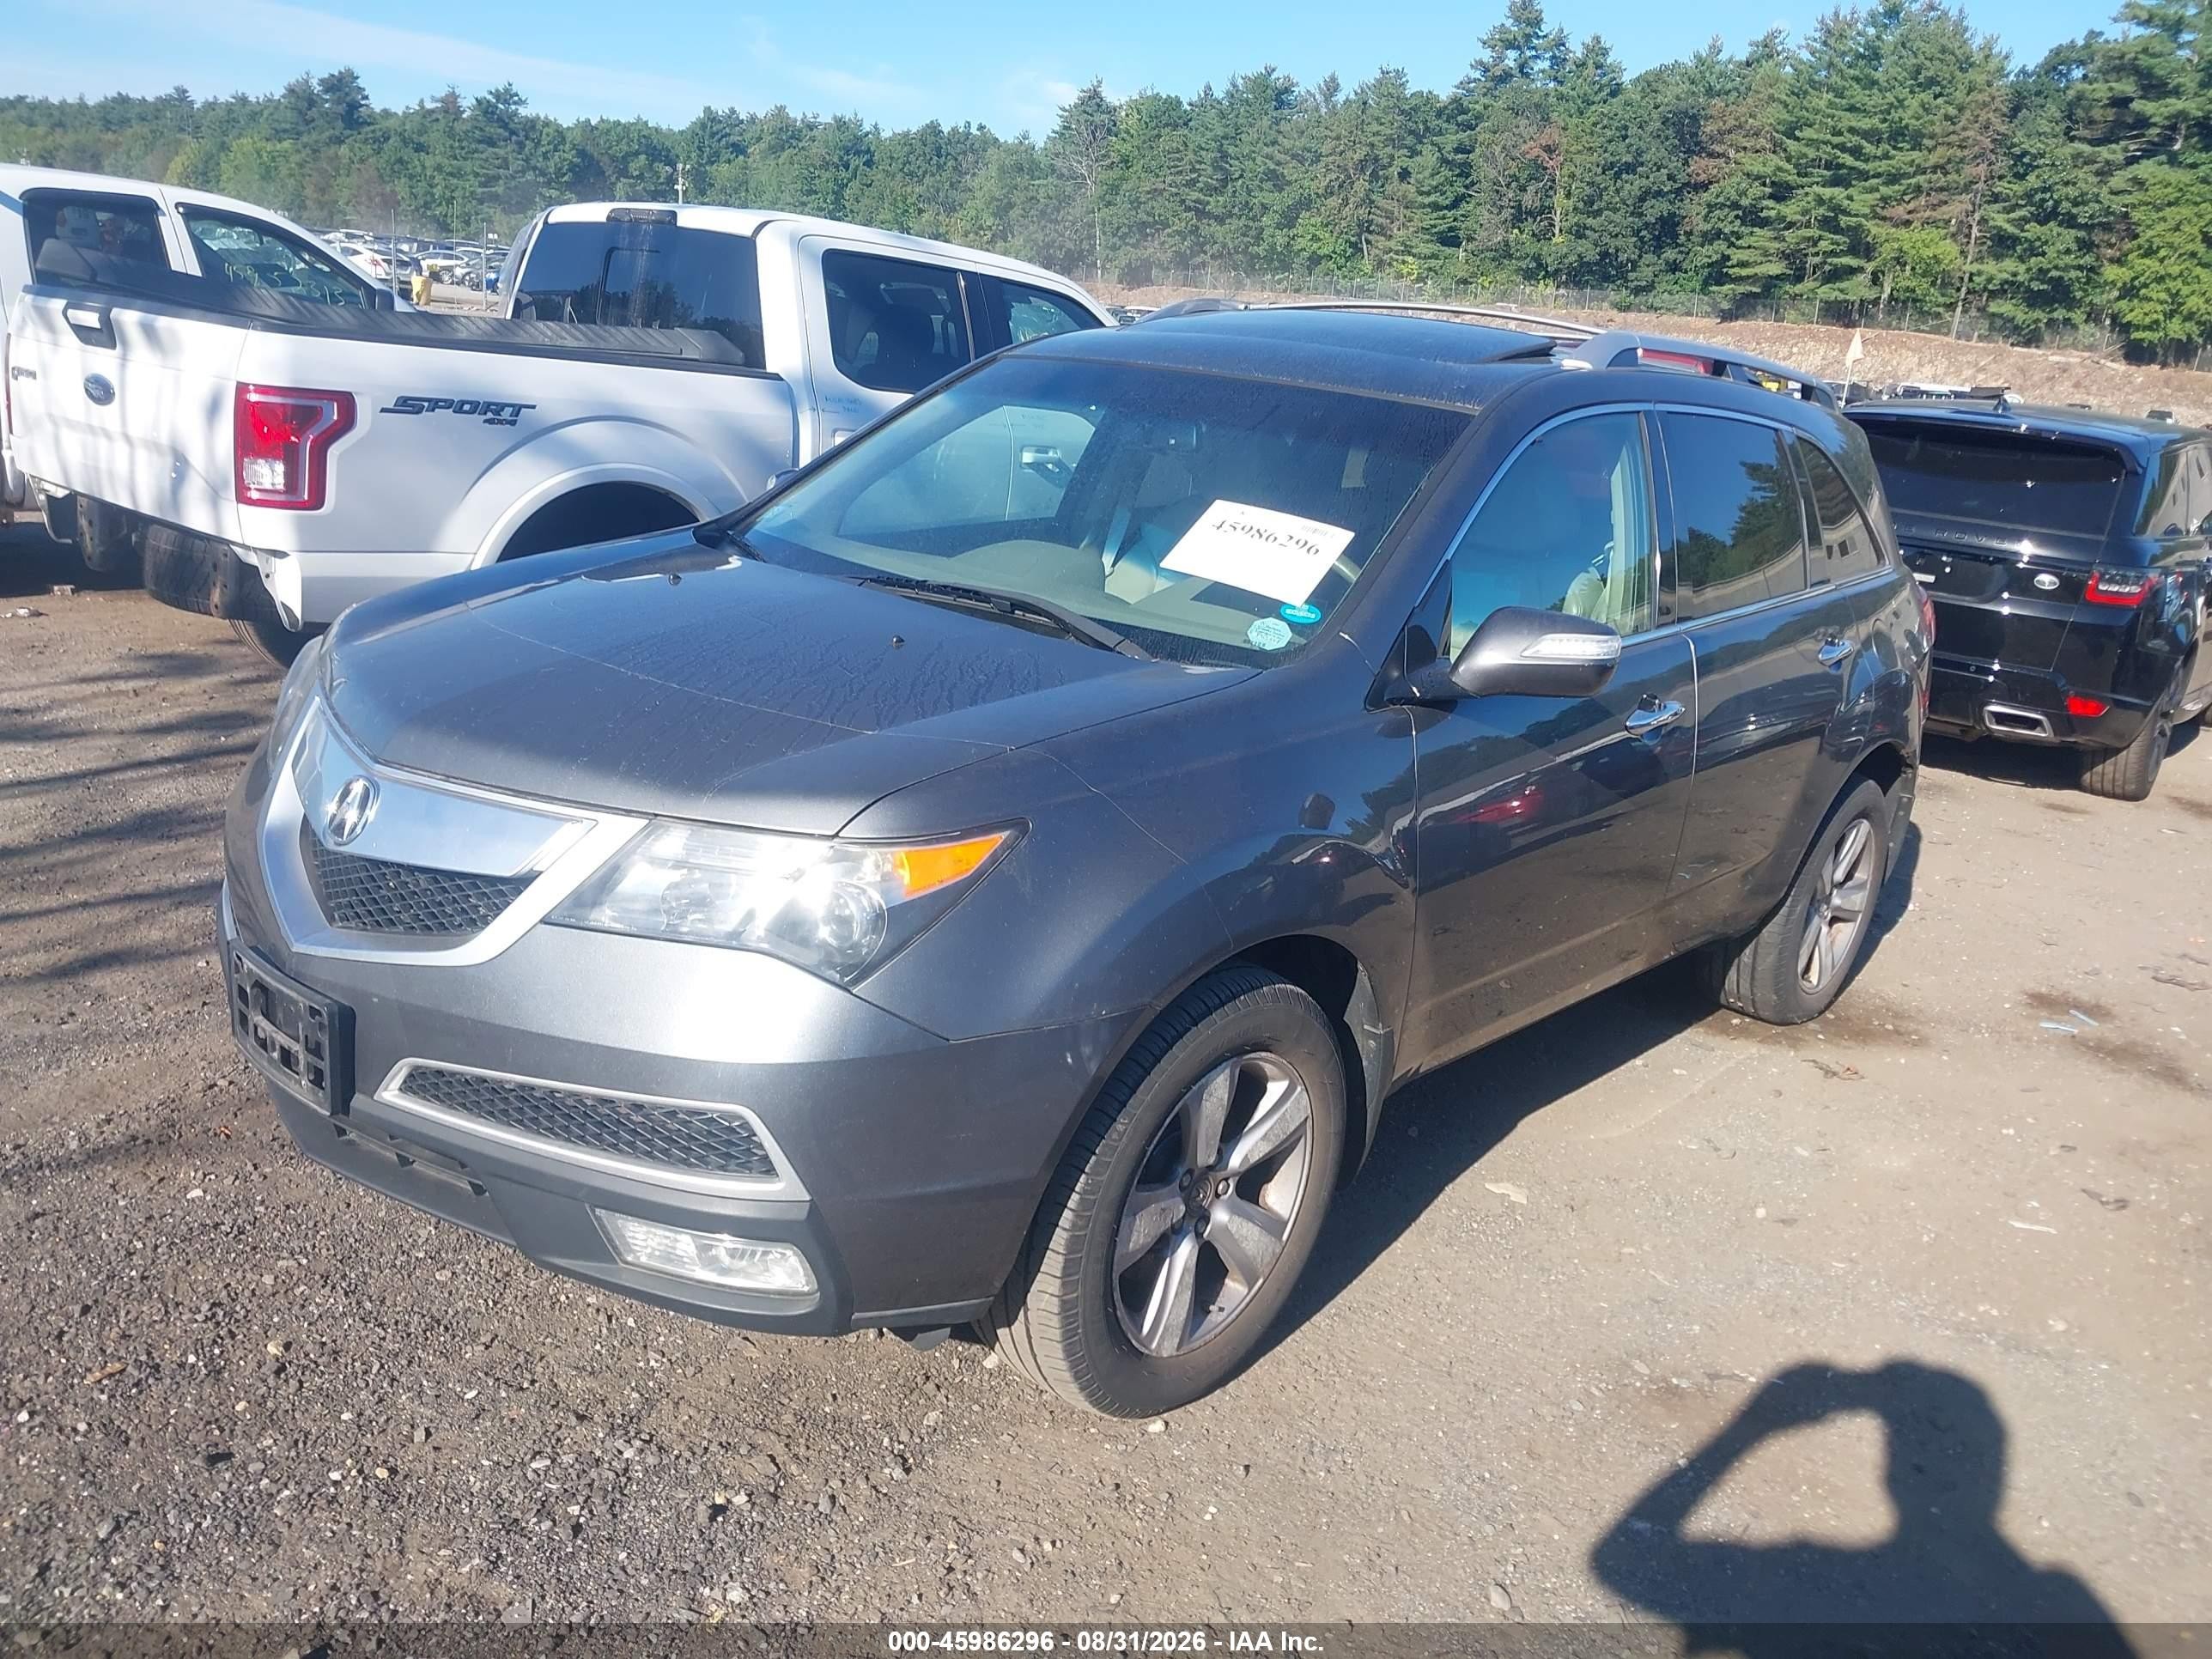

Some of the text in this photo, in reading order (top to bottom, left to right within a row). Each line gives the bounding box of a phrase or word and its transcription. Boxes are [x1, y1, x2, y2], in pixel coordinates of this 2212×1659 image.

[379, 395, 538, 418] SPORT
[1212, 519, 1320, 556] 45986296
[1934, 527, 2028, 550] ROVE
